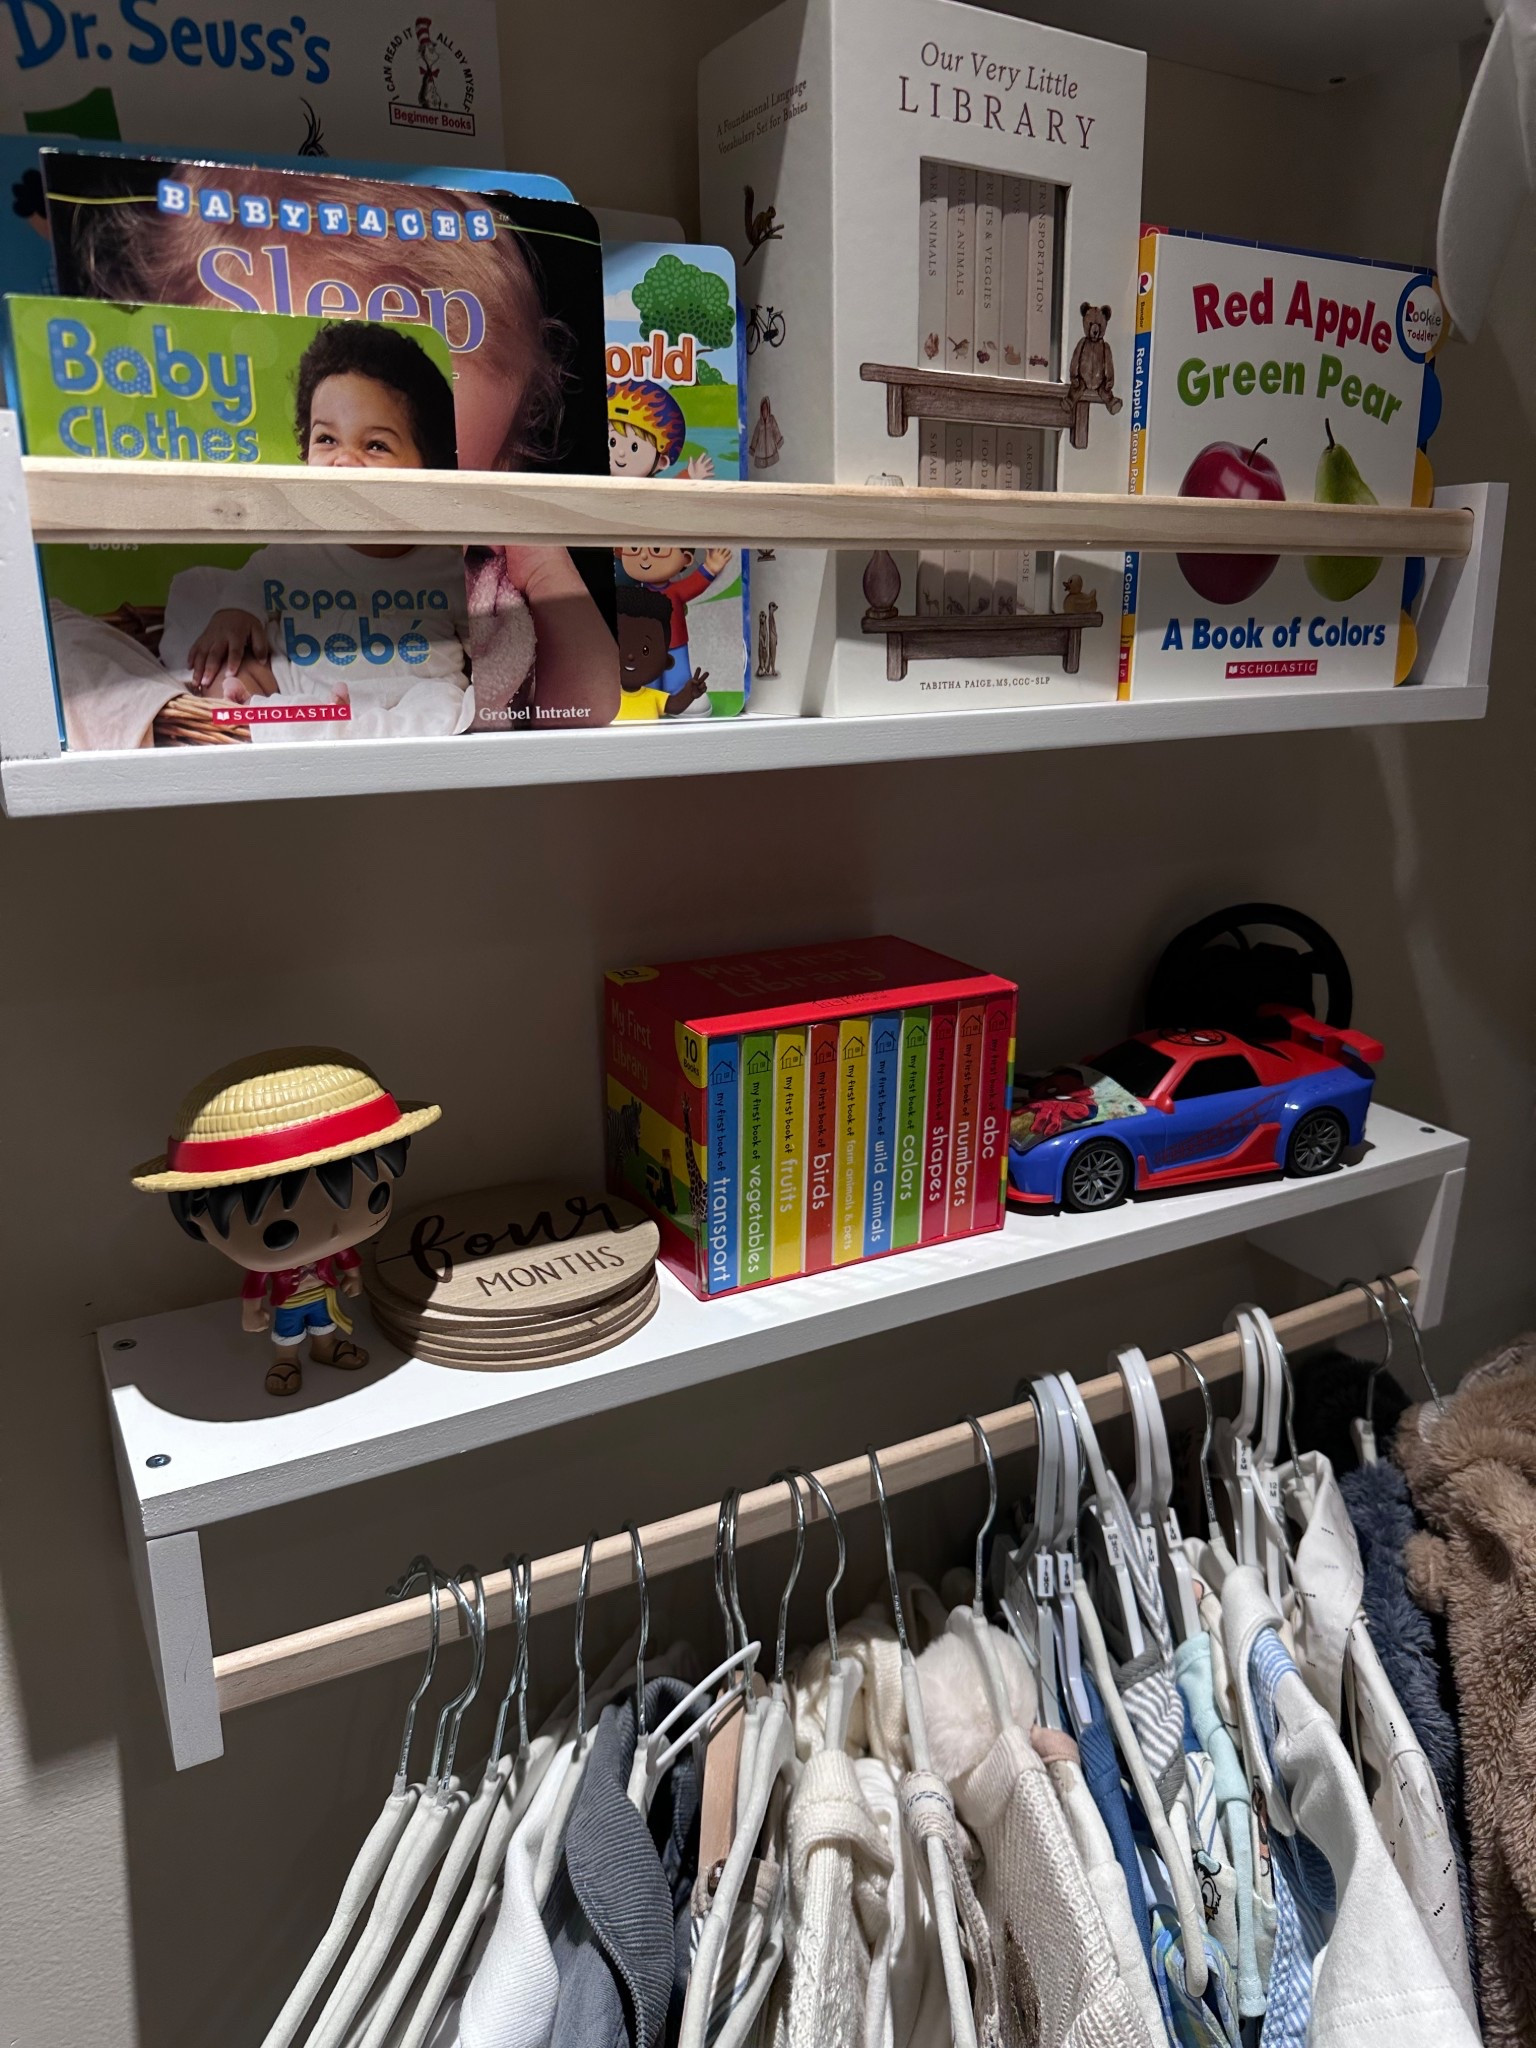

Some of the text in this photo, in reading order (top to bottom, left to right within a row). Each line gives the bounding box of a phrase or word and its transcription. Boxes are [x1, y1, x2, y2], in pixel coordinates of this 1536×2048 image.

[8, 0, 330, 84] Dr. Seuss's
[384, 35, 402, 63] READ
[402, 28, 413, 40] IT
[384, 66, 396, 92] CAN
[437, 33, 475, 113] ALL BY MYSELF
[921, 42, 1078, 100] Our Very Little
[394, 108, 472, 130] Beginner Books
[718, 102, 808, 154] Vocabulary Set for Babies
[724, 96, 769, 133] Foundational
[771, 80, 807, 107] Language
[898, 76, 1096, 150] LIBRARY
[160, 182, 494, 239] BABYFACES
[985, 231, 993, 240] &
[928, 210, 938, 276] ANIMALS
[956, 231, 966, 296] ANIMALS
[1035, 183, 1047, 313] TRANSPORTATION
[984, 246, 993, 309] VEGGIES
[1193, 277, 1392, 354] Red Apple
[1405, 301, 1441, 326] Rookie
[1407, 330, 1434, 342] Toddler
[47, 318, 256, 426] Baby
[605, 333, 694, 382] orld
[1177, 354, 1403, 425] Green Pear
[58, 407, 260, 463] Clothes
[1129, 347, 1145, 495] Red Apple Green Pea
[929, 432, 938, 481] SAFARI
[954, 438, 963, 487] OCEAN
[1005, 441, 1014, 490] CLOTH
[1026, 445, 1034, 491] AROUN
[264, 579, 448, 619] Ropa para
[1122, 555, 1133, 615] of Colors
[283, 616, 430, 666] bebé
[1161, 615, 1386, 651] A Book of Colors
[920, 680, 961, 691] TABITHA
[1239, 661, 1316, 675] SCHOLASTIC
[232, 705, 349, 721] SCHOLASTIC
[478, 703, 591, 721] Grobel Intrater
[684, 1035, 698, 1063] 10
[847, 1065, 854, 1079] my
[964, 1058, 972, 1081] first
[965, 1044, 972, 1057] my
[847, 1080, 856, 1103] first
[847, 1104, 856, 1126] book
[963, 1083, 972, 1107] book
[780, 1076, 798, 1213] my first book of fruits
[812, 1072, 831, 1211] my first book of birds
[847, 1128, 855, 1136] of
[871, 1060, 888, 1242] my first book of wild animals
[900, 1055, 918, 1200] my first book of colors
[982, 1116, 1000, 1159] abc
[709, 1093, 731, 1282] my first book of transport
[746, 1082, 765, 1273] my first book of vegetables
[928, 1126, 948, 1202] shapes
[954, 1121, 972, 1207] numbers
[376, 1196, 652, 1283] four
[476, 1246, 625, 1297] MONTHS
